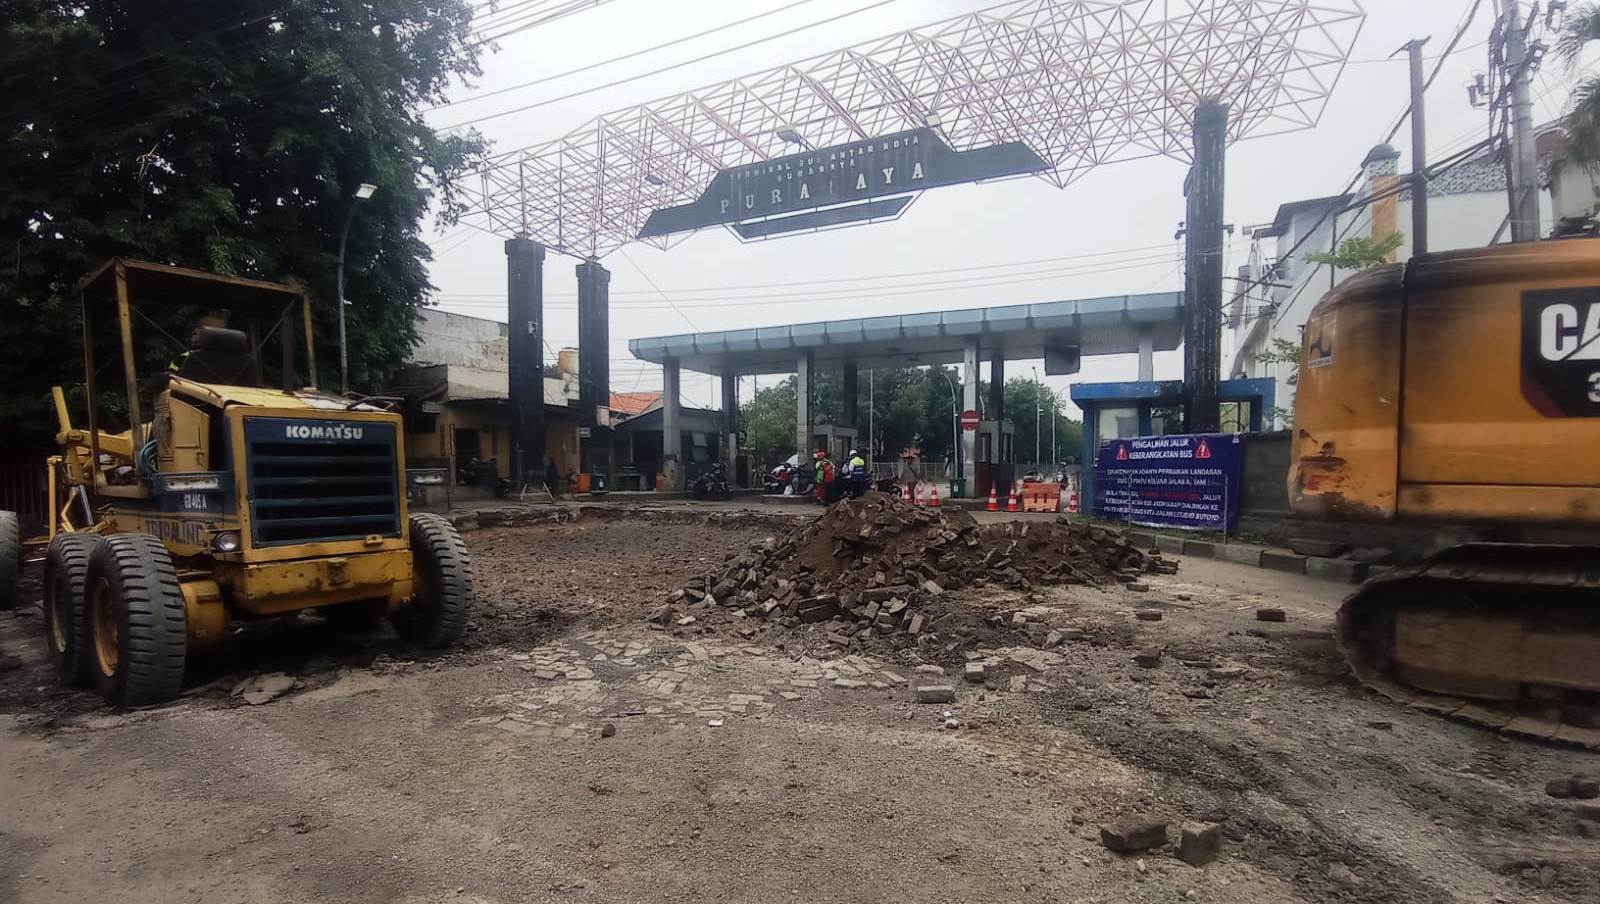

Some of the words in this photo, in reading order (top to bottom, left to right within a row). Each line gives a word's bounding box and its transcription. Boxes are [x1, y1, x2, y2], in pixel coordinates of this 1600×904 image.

[830, 145, 874, 161] ANTAR
[720, 162, 924, 214] PURAAYA
[286, 425, 363, 440] KOMATSU
[1131, 440, 1169, 449] PENGALIHAN
[1169, 438, 1190, 447] JALUR
[1128, 450, 1179, 459] KEBERANGKATAN
[1179, 449, 1193, 458] BUS
[1190, 468, 1222, 476] LANDASAN
